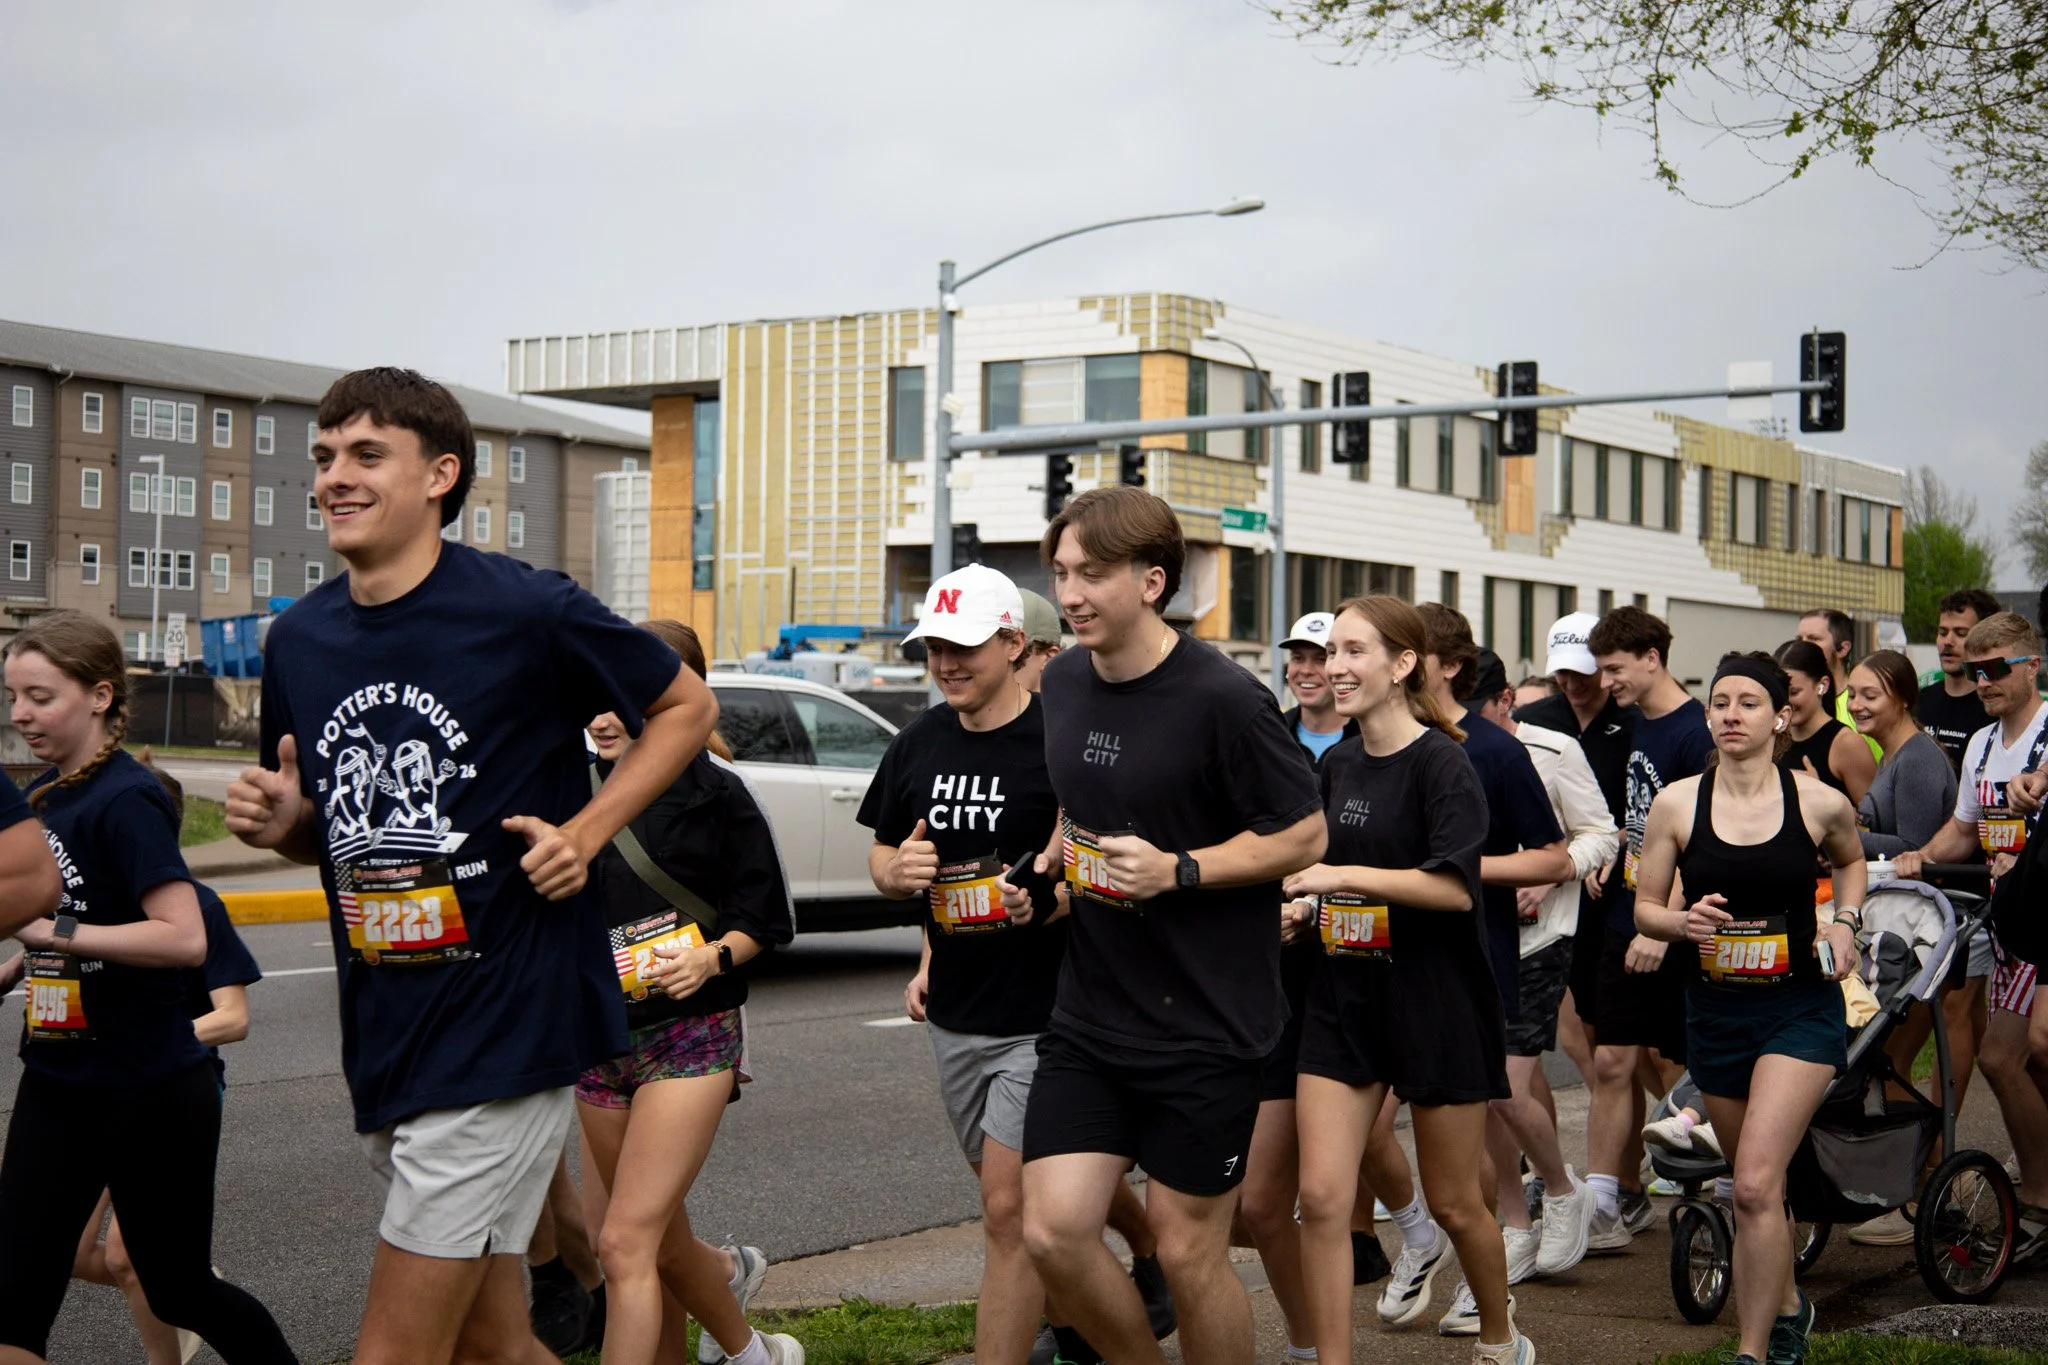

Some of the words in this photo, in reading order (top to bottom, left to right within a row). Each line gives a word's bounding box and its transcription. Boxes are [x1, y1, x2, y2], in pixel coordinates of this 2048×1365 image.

[933, 588, 963, 614] N
[168, 630, 183, 643] 20
[316, 682, 397, 759] POTTER'S
[401, 684, 469, 751] HOUSE
[1087, 731, 1122, 751] HILL
[1938, 728, 1967, 739] PARAGUAY
[1083, 748, 1119, 767] CITY
[458, 764, 477, 779] 26
[1642, 756, 1665, 792] HOUS
[931, 774, 1005, 802] HILL
[929, 804, 1004, 832] CITY
[1344, 798, 1370, 814] HILL
[1339, 812, 1369, 828] CITY
[1987, 824, 2018, 848] 2237
[455, 859, 489, 880] RUN
[1077, 850, 1117, 891] 216
[73, 900, 88, 912] 26
[945, 884, 991, 918] 2118
[362, 896, 444, 942] 2223
[1331, 910, 1375, 943] 2198
[80, 960, 104, 973] RUN
[1716, 940, 1778, 970] 2089
[31, 984, 68, 1023] 1996
